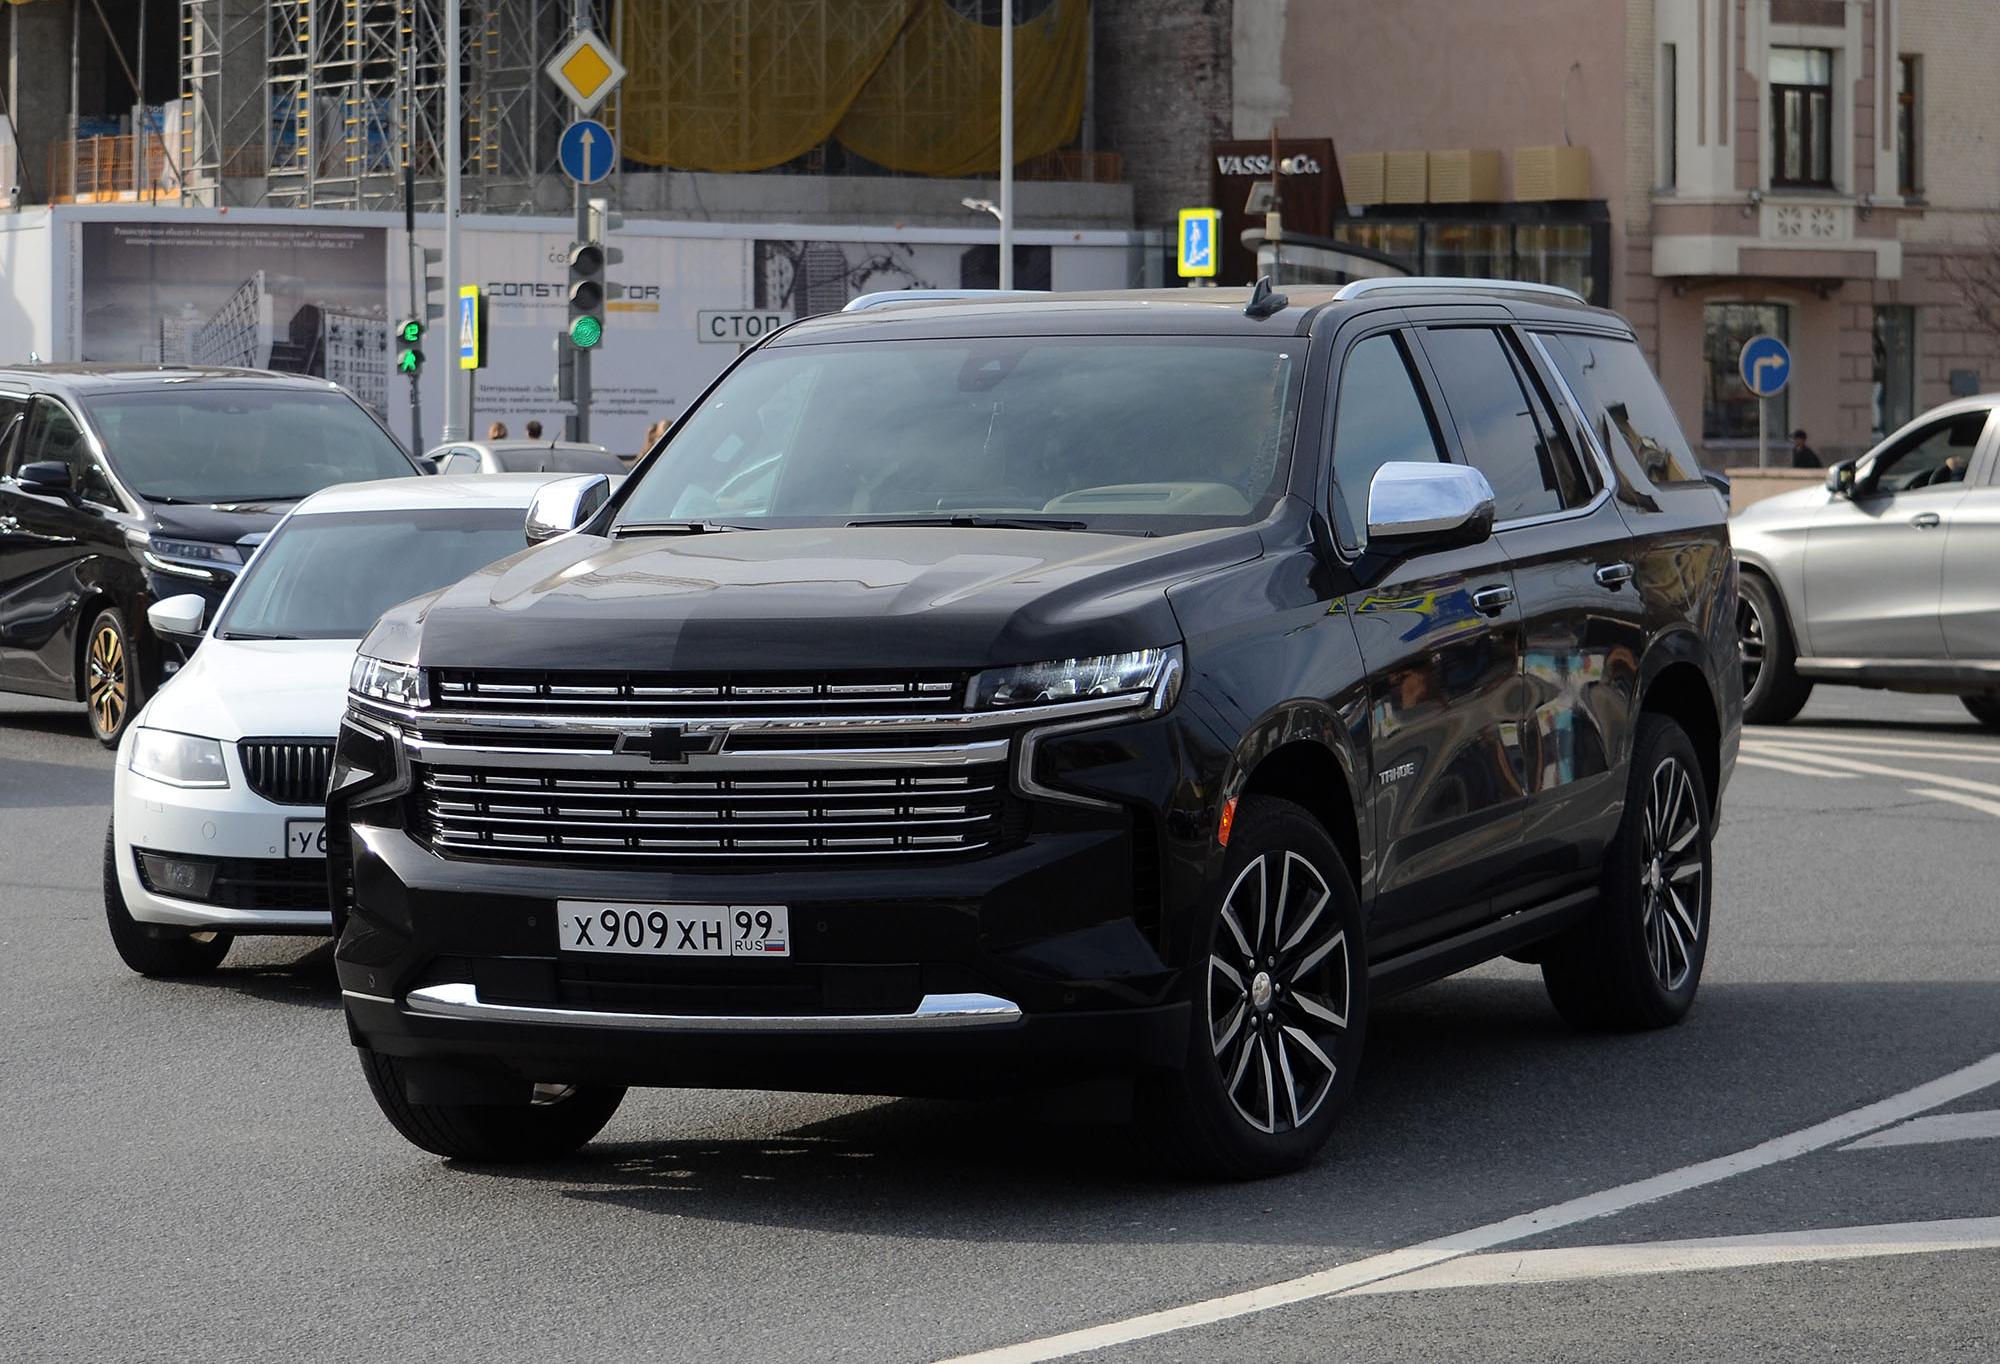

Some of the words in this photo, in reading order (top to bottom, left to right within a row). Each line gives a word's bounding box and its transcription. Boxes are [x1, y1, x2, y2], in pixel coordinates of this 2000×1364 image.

[711, 316, 780, 337] СТОП
[1378, 762, 1415, 785] TAHOE
[735, 910, 773, 939] 99
[735, 940, 763, 951] RUS
